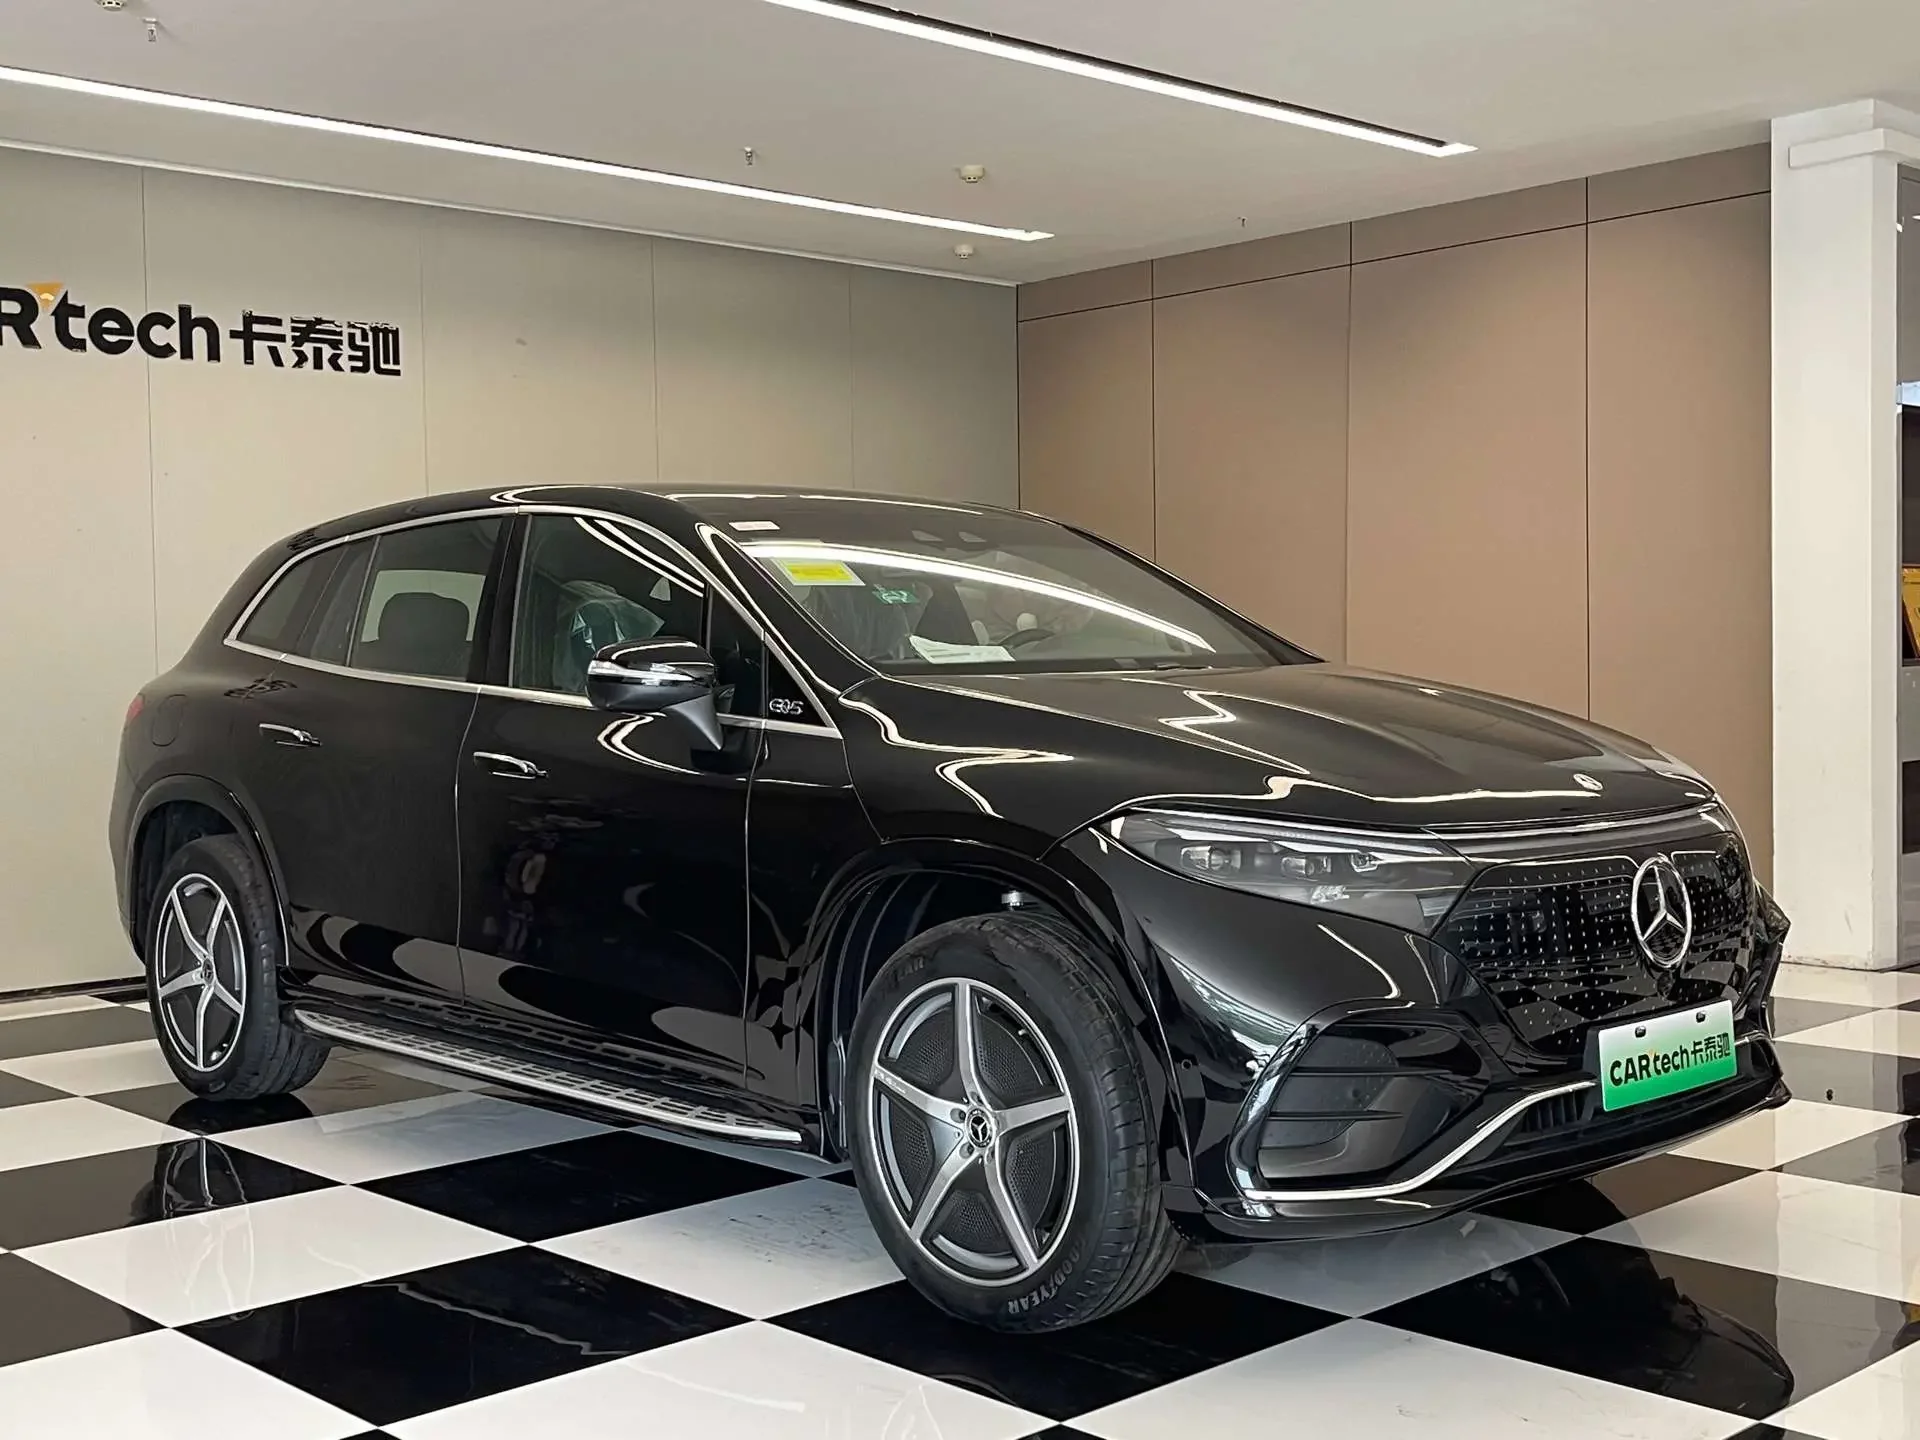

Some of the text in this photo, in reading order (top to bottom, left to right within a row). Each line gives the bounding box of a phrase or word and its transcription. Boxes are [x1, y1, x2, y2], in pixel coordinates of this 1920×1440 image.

[229, 309, 401, 376] 卡泰驰
[769, 698, 804, 715] EQS
